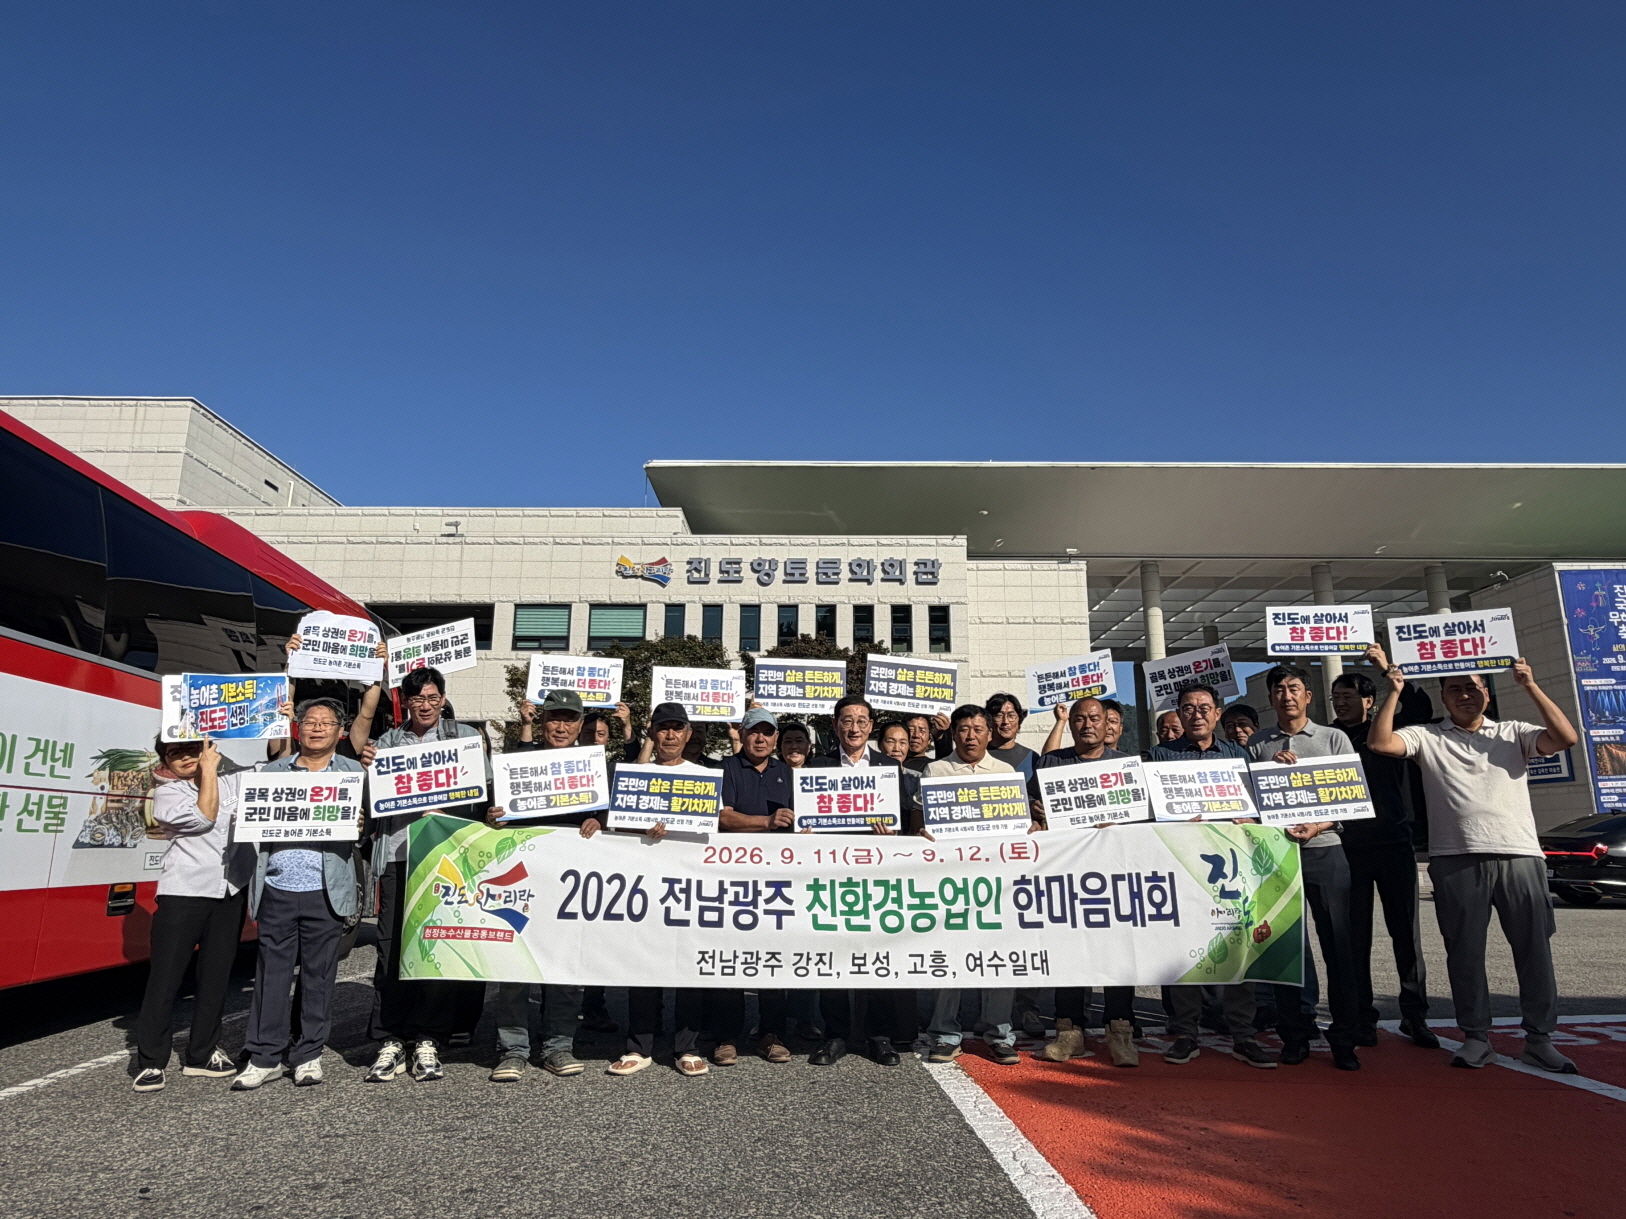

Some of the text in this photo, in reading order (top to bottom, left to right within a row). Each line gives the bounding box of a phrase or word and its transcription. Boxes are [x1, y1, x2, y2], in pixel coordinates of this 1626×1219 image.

[686, 556, 942, 586] 진도향토문화회관
[1272, 612, 1349, 626] 진도에 살아서
[303, 626, 320, 637] 골목
[322, 626, 347, 640] 상권의
[347, 629, 376, 645] 온기를,
[1289, 625, 1348, 642] 참 좋다!
[1395, 619, 1486, 642] 진도에 살아서
[302, 638, 348, 655] 군민 마음에
[1416, 636, 1487, 660] 참 좋다!
[542, 665, 610, 678] 든든해서 참 좋다!
[758, 669, 843, 685] 군민의 삶은 든든하게,
[870, 666, 954, 687] 군민의 삶은 든든하게,
[1037, 661, 1100, 684] 든든해서 참 좋다!
[1149, 658, 1224, 683] 골목 상권의 온기를,
[541, 676, 611, 690] 행복해서 더 좋다!
[665, 678, 733, 691] 든든해서 참 좋다!
[758, 684, 843, 698] 지역 경제는 활기차게!
[869, 680, 953, 701] 지역 경제는 활기차게!
[1038, 673, 1104, 695] 행복해서 더 좋다!
[1154, 683, 1174, 697] 군민
[189, 684, 219, 708] 농어촌
[220, 680, 257, 704] 기본소득!
[664, 690, 734, 703] 행복해서 더 좋다!
[1043, 694, 1067, 706] 농어촌
[198, 706, 228, 734] 진도군
[229, 703, 250, 730] 선정!
[695, 706, 731, 716] 기본소득!
[23, 736, 75, 779] 건넨
[374, 749, 459, 776] 진도에 살아서
[509, 760, 591, 780] 든든해서 참 좋다!
[1160, 770, 1236, 786] 든든해서 참 좋다!
[1257, 767, 1362, 790] 군민의 삶은 든든하게,
[394, 766, 458, 795] 참 좋다!
[510, 775, 595, 796] 행복해서 더 좋다!
[617, 777, 718, 797] 군민의 삶은 든든하게,
[799, 775, 876, 793] 진도에 살아서
[1044, 772, 1137, 796] 골목 상권의 온기를,
[244, 787, 269, 802] 골목
[271, 787, 307, 801] 상권의
[310, 786, 352, 803] 온기를,
[516, 792, 593, 811] 농어촌 기본소득!
[926, 785, 1024, 804] 군민의 삶은 든든하게,
[1050, 788, 1146, 813] 군민 마음에 희망을!
[1163, 784, 1243, 800] 행복해서 더 좋다!
[1261, 785, 1367, 807] 지역 경제는 활기차게!
[16, 792, 69, 833] 선물
[244, 805, 357, 822] 군민 마음에 희망을!
[615, 794, 717, 814] 지역 경제는 활기차게!
[816, 793, 875, 814] 참 좋다!
[928, 802, 1027, 821] 지역 경제는 활기차게!
[1172, 801, 1244, 814] 농어촌 기본소득!
[1069, 810, 1130, 826] 진도군 농어촌 기본소득
[261, 828, 332, 838] 진도군 농어촌 기본소득
[703, 846, 771, 866] 2026.
[780, 847, 802, 865] 9.
[923, 848, 945, 863] 9.
[955, 845, 990, 863] 12.
[999, 839, 1040, 864] (토)
[556, 868, 1181, 933] 2026 전남광주 친환경농업인 한마음대회
[424, 928, 513, 940] 청정농수산물공동브랜드
[696, 948, 1051, 979] 전남광주 강진, 보성, 고흥, 여수일대
